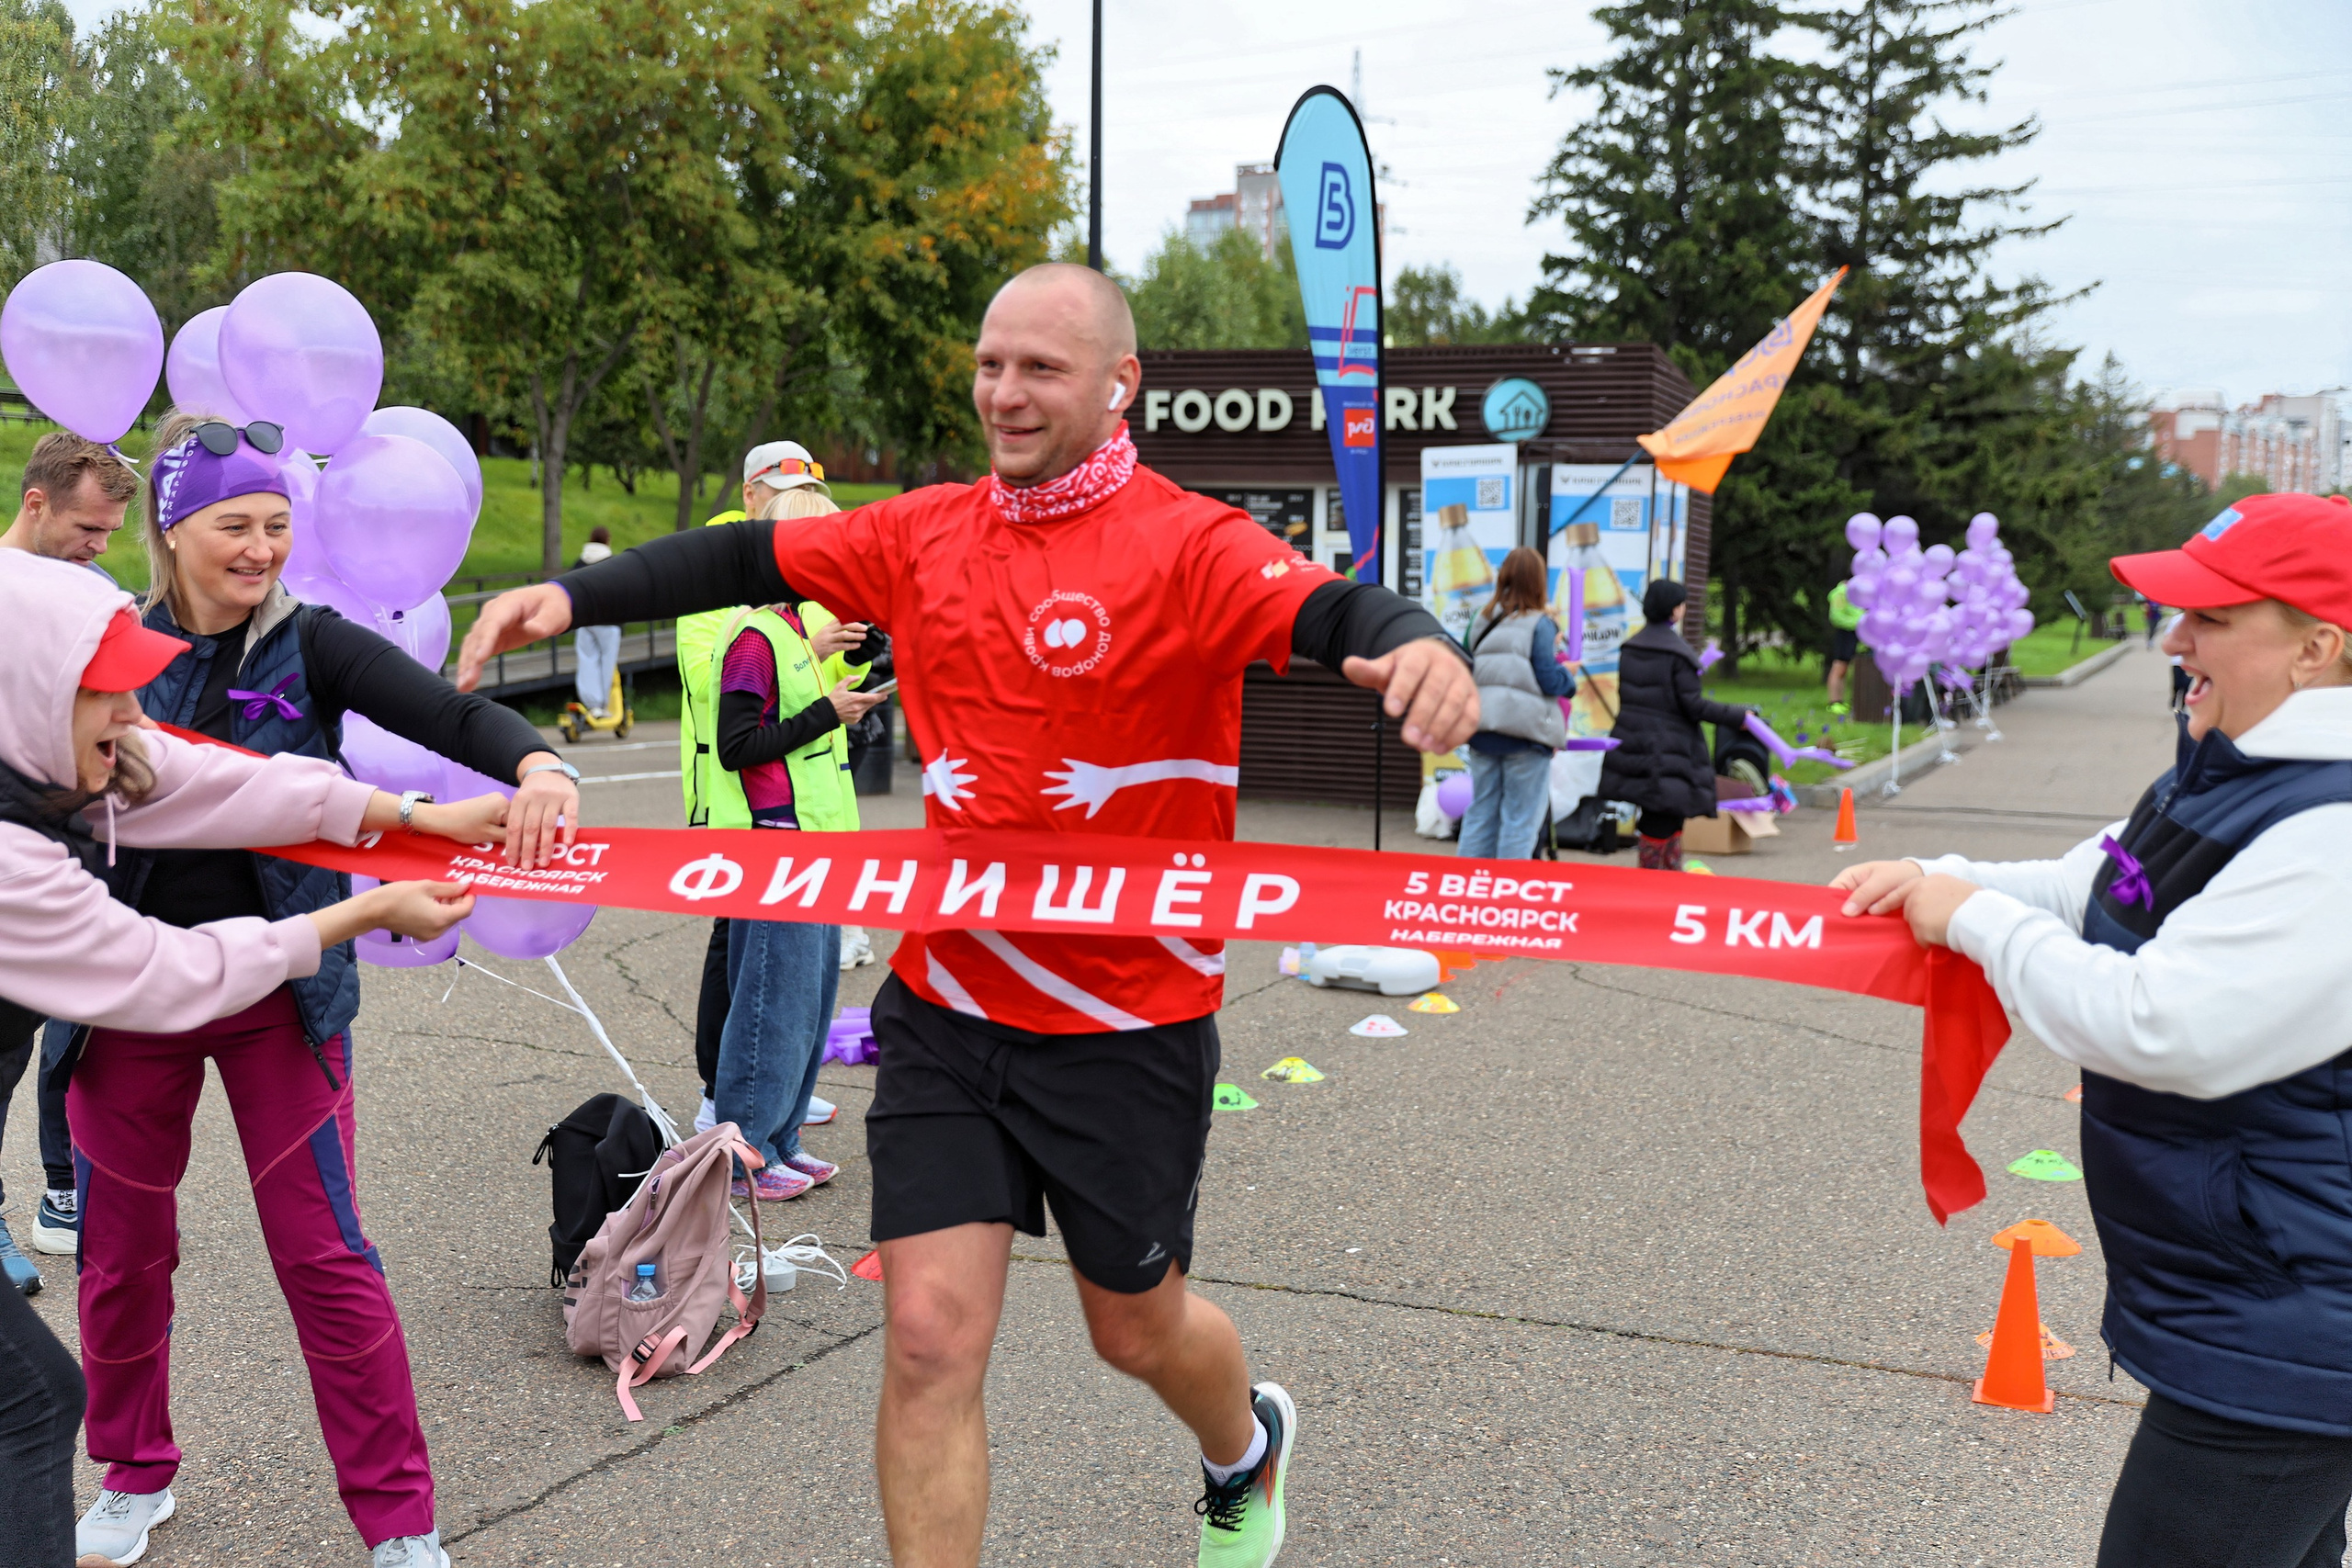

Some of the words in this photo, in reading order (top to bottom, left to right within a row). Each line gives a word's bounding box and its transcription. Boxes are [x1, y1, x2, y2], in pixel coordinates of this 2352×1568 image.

[1145, 388, 1294, 433] FOOD
[1029, 589, 1111, 626] сообщество
[1023, 626, 1049, 671] крови
[1051, 630, 1112, 678] доноров
[449, 855, 609, 884] КРАСНОЯРСК
[1403, 871, 1430, 896] 5
[1438, 868, 1573, 903] ВЁРСТ
[669, 852, 1301, 930] ФИНИШЁР
[1383, 899, 1579, 933] КРАСНОЯРСК
[1669, 904, 1707, 944] 5
[1724, 908, 1825, 950] КМ
[1390, 928, 1563, 950] НАБЕРЕЖНАЯ
